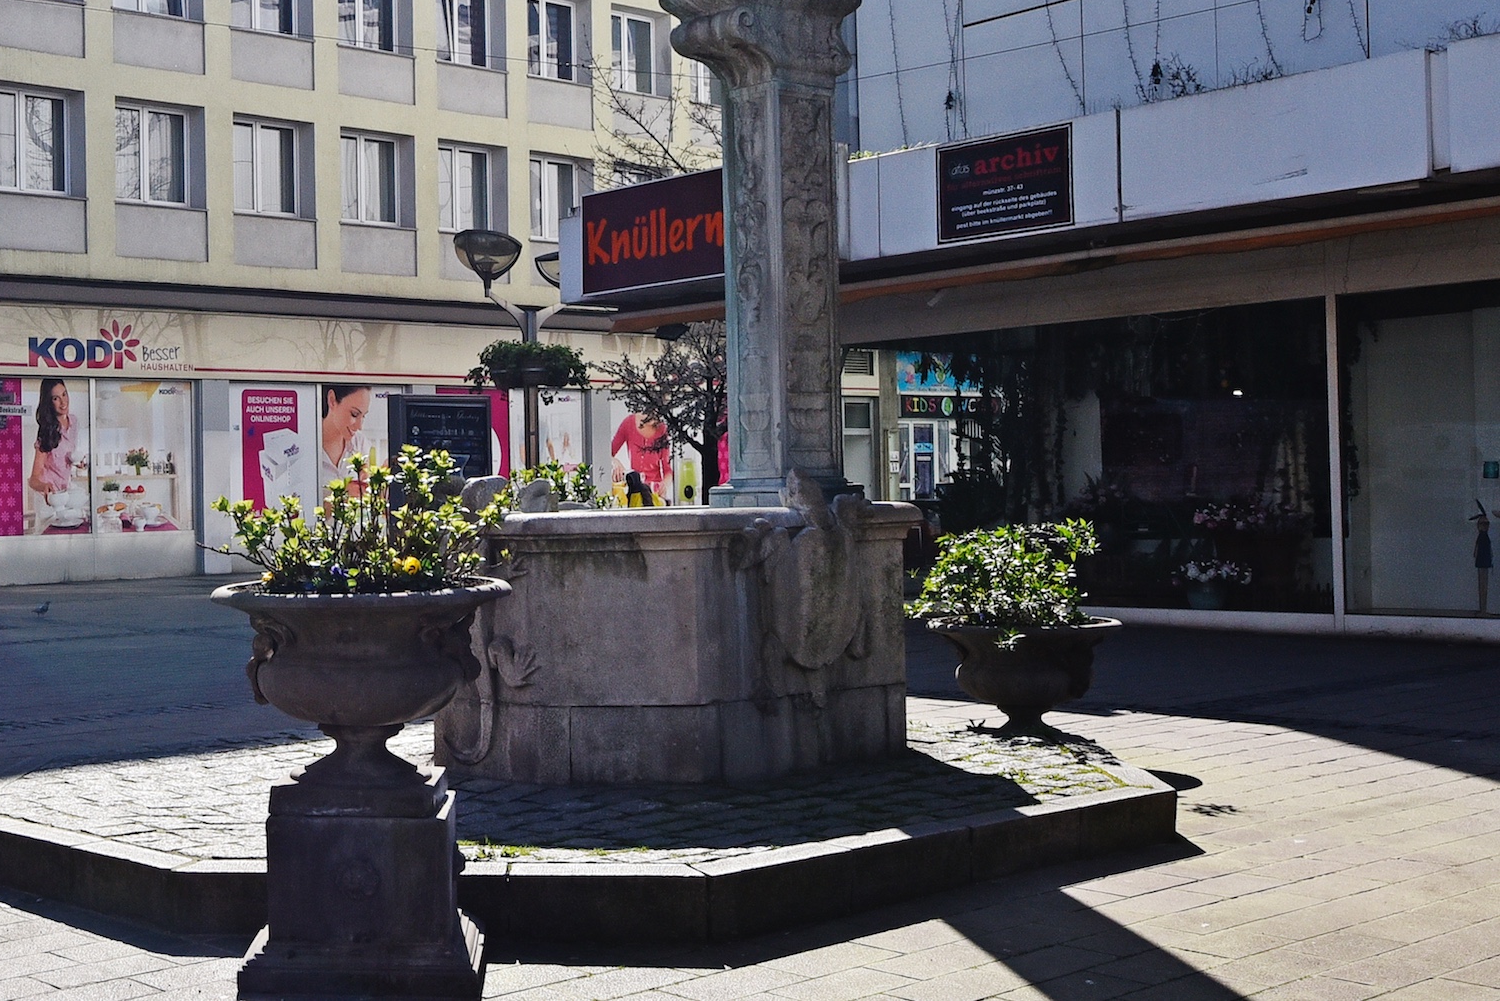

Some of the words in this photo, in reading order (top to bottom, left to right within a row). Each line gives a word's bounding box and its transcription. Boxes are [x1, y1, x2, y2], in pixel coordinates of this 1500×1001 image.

[974, 143, 1059, 175] archiv
[951, 204, 972, 213] eingang
[993, 197, 1018, 206] rückseite
[1030, 190, 1058, 200] gebäudes
[956, 222, 968, 230] post
[142, 345, 180, 361] Besser
[140, 363, 194, 372] HAUSHALTEN
[247, 396, 282, 404] BESUCHEN
[906, 397, 937, 413] KIDS
[265, 406, 295, 414] UNSEREN
[250, 415, 291, 423] ONLINESHOP
